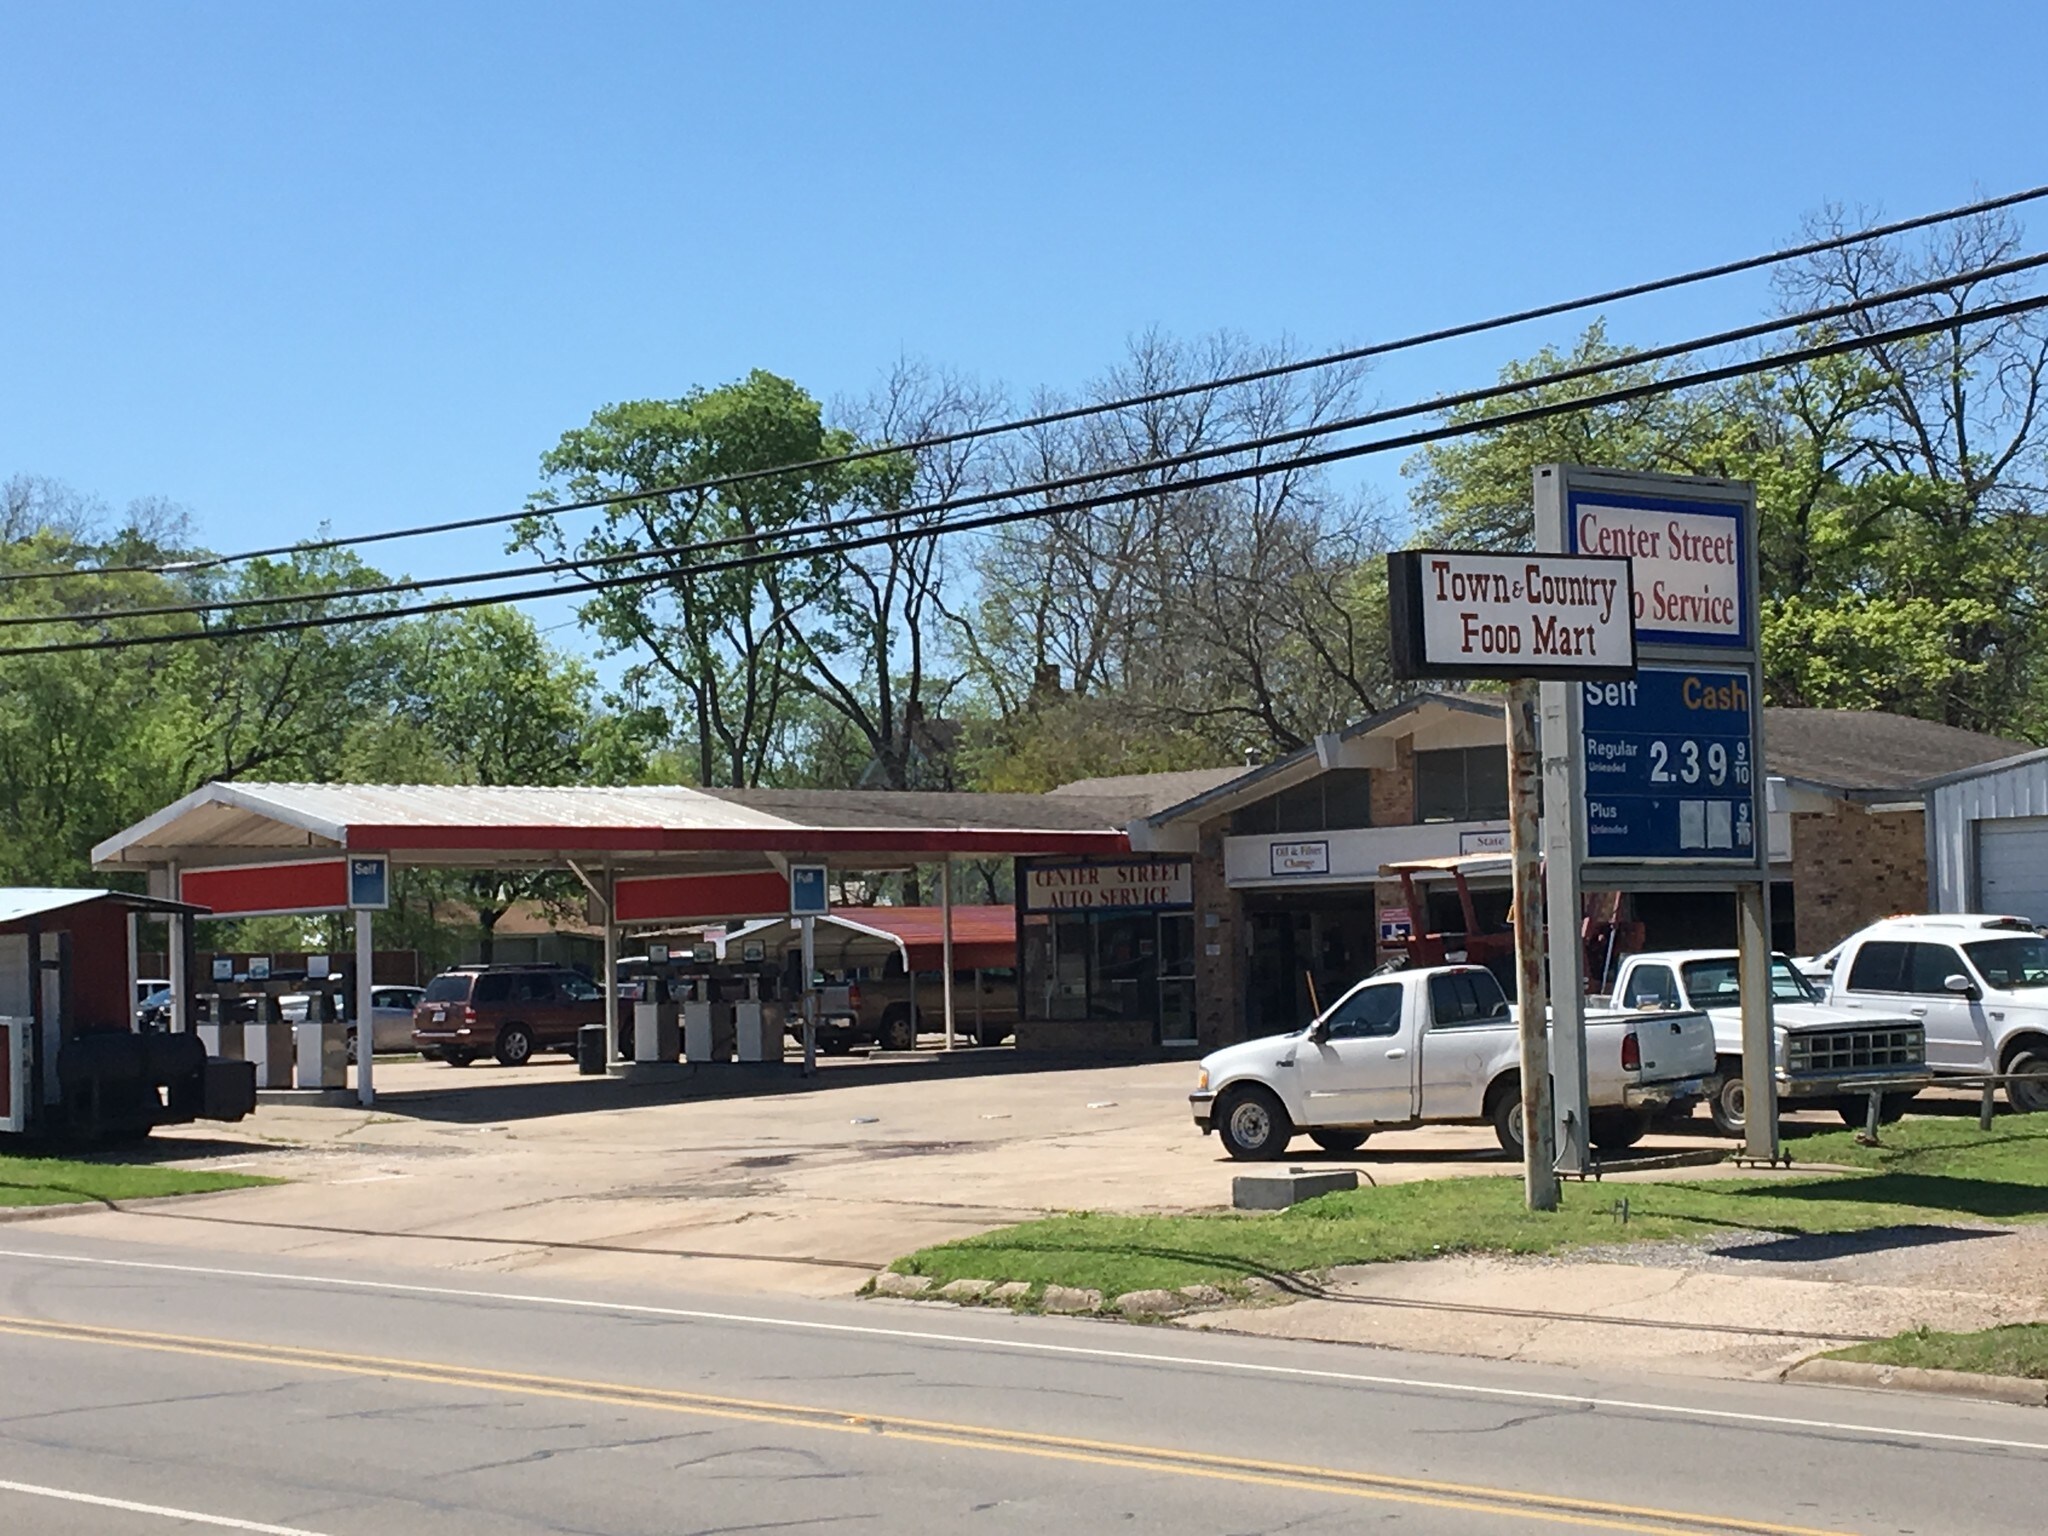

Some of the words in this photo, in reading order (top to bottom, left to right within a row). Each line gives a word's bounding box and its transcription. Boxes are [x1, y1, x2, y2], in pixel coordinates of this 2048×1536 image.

[1579, 513, 1660, 559] Center
[1667, 520, 1735, 565] Street
[1652, 580, 1734, 625] Service
[1531, 614, 1597, 656] Mart
[1586, 680, 1638, 707] Self
[1682, 676, 1747, 712] Cash
[1587, 738, 1638, 760] Regular
[1590, 801, 1618, 819] Plus
[354, 862, 378, 875] Self
[1035, 868, 1099, 888] CENTER
[1117, 863, 1181, 884] STREET
[1050, 890, 1093, 909] AUTO
[1101, 886, 1171, 906] SERVICE
